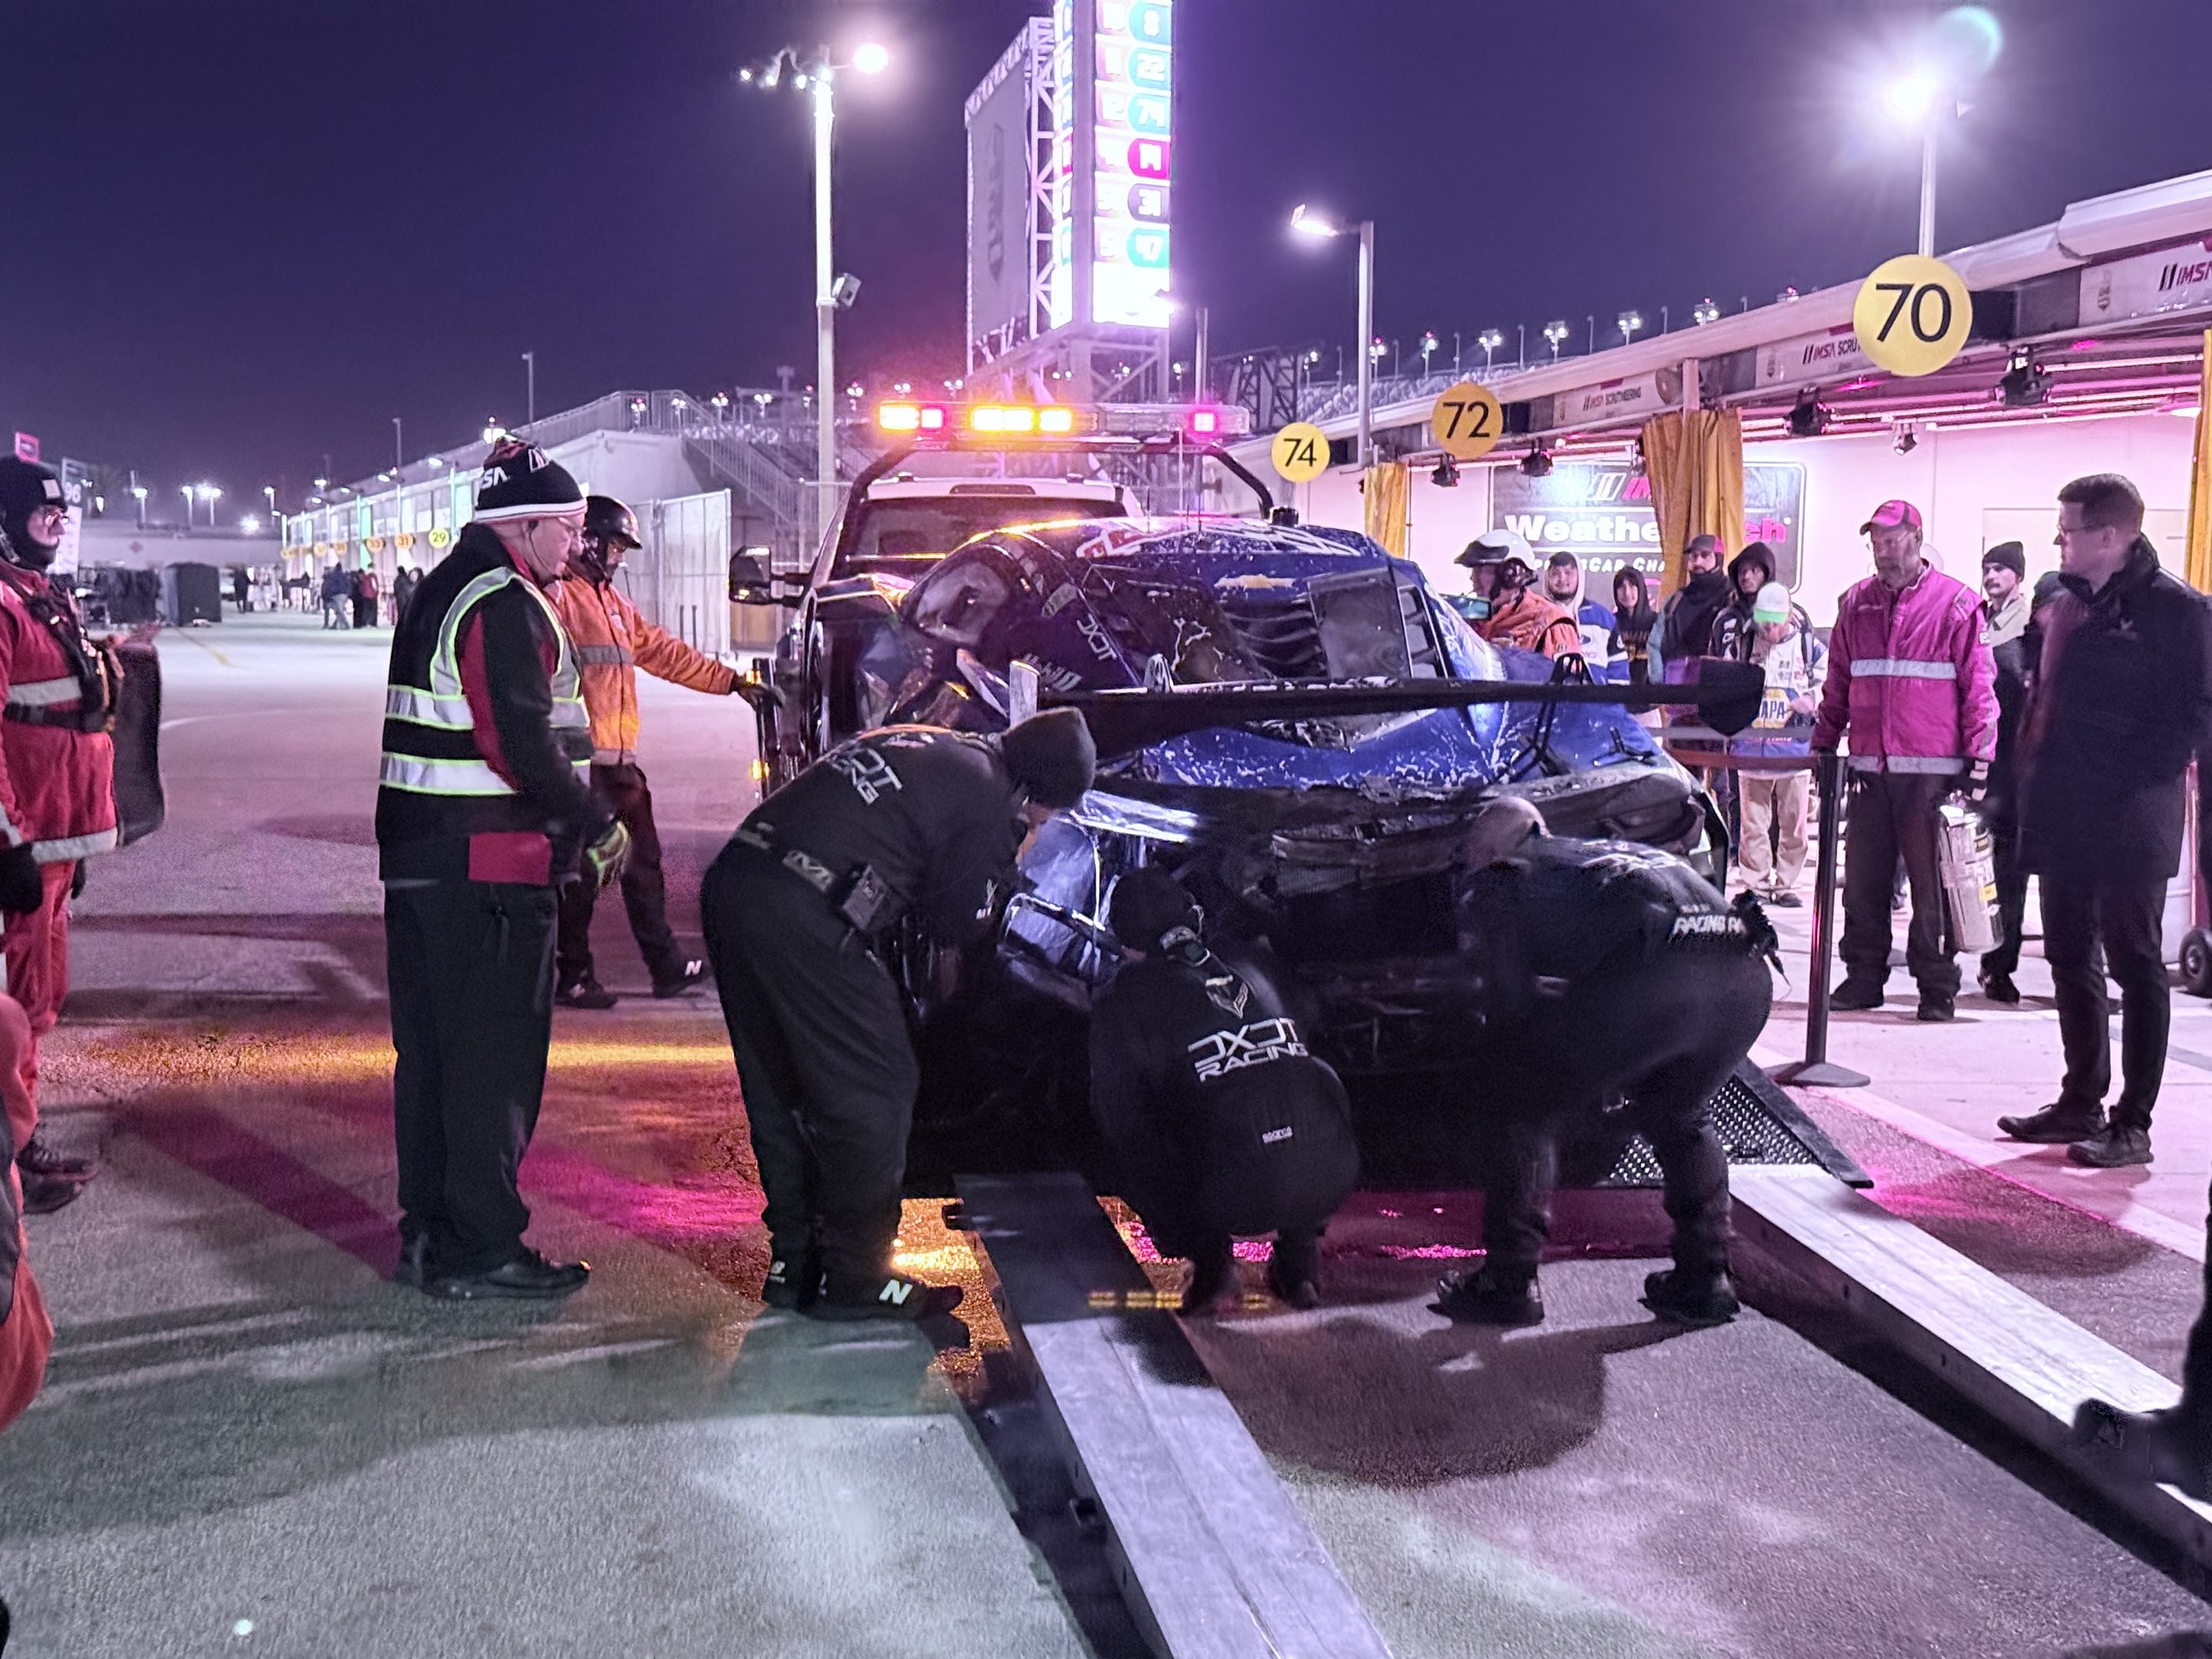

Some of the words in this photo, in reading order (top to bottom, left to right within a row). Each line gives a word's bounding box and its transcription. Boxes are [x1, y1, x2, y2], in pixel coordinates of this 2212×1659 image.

[1876, 283, 1952, 343] 70
[1442, 402, 1490, 439] 72
[1283, 439, 1317, 467] 74
[432, 531, 446, 543] 29
[1760, 700, 1786, 719] APA
[1198, 1041, 1309, 1082] RACING
[879, 1280, 913, 1305] N
